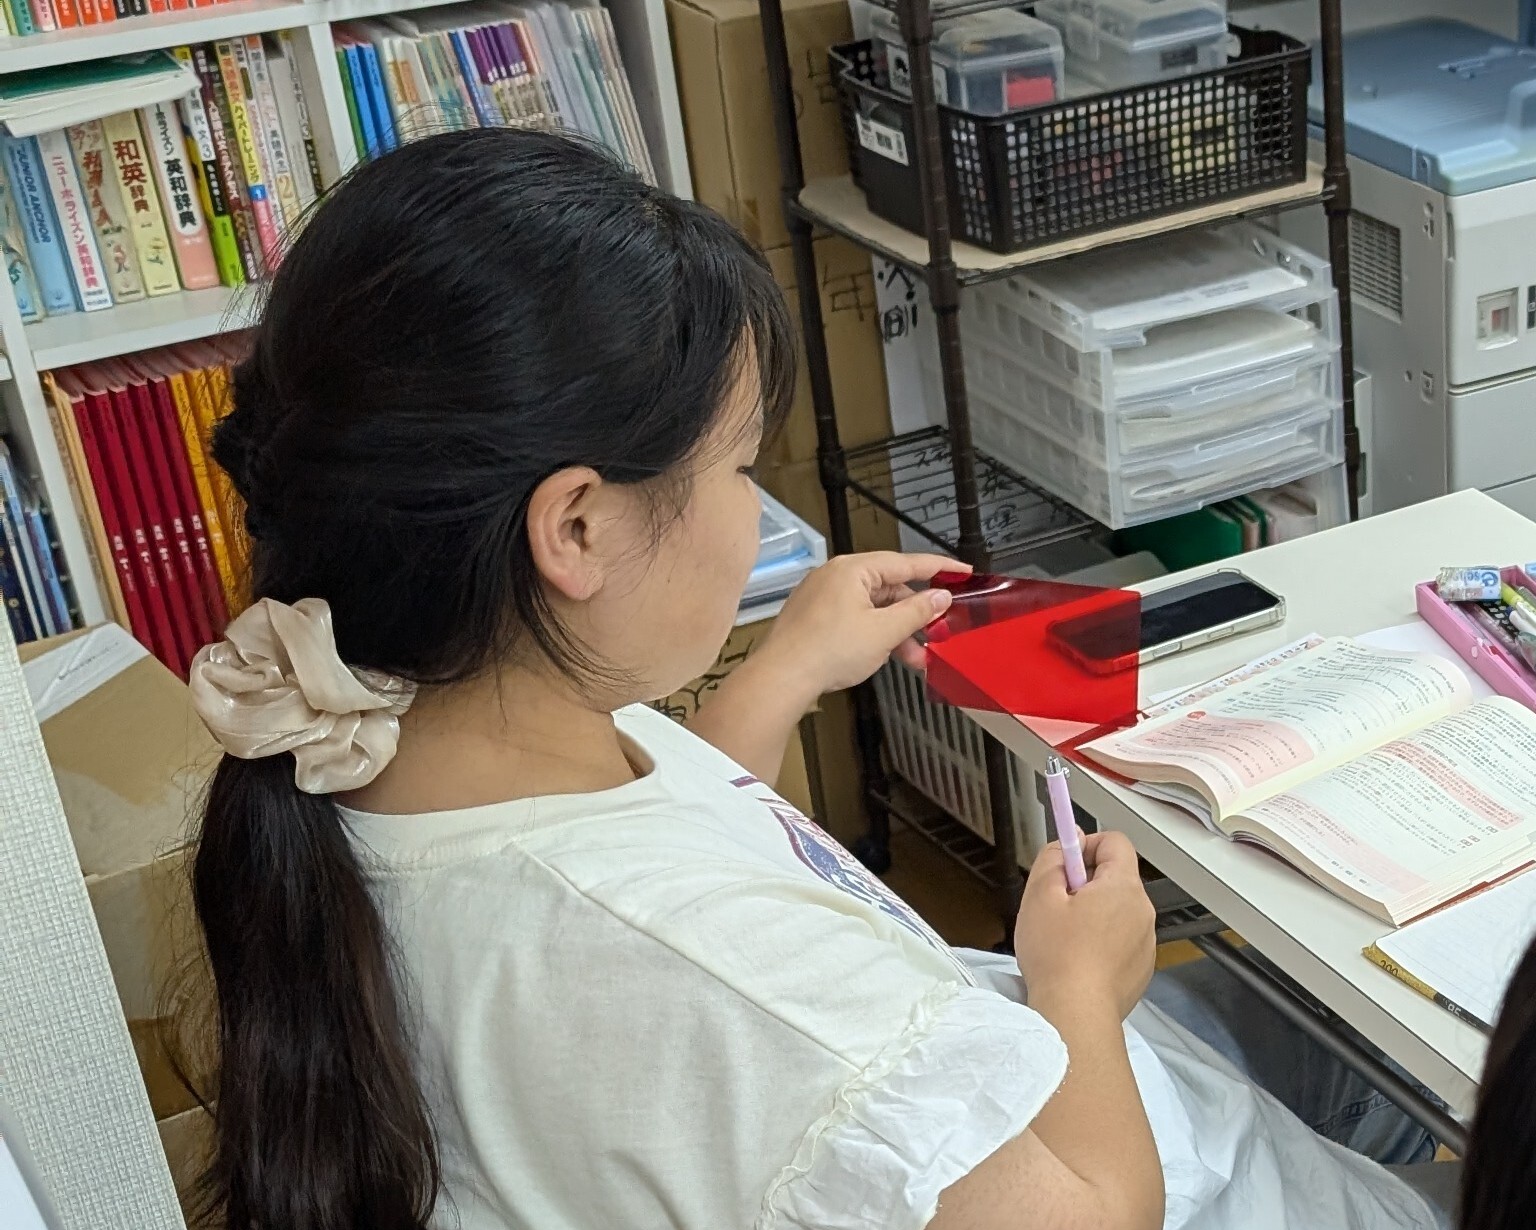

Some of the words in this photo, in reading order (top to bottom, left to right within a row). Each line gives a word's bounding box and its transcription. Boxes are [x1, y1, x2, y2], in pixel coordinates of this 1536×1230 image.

[17, 143, 37, 193] JUNIOR
[29, 194, 52, 243] ANCHOR
[164, 158, 197, 228] 英和辞典
